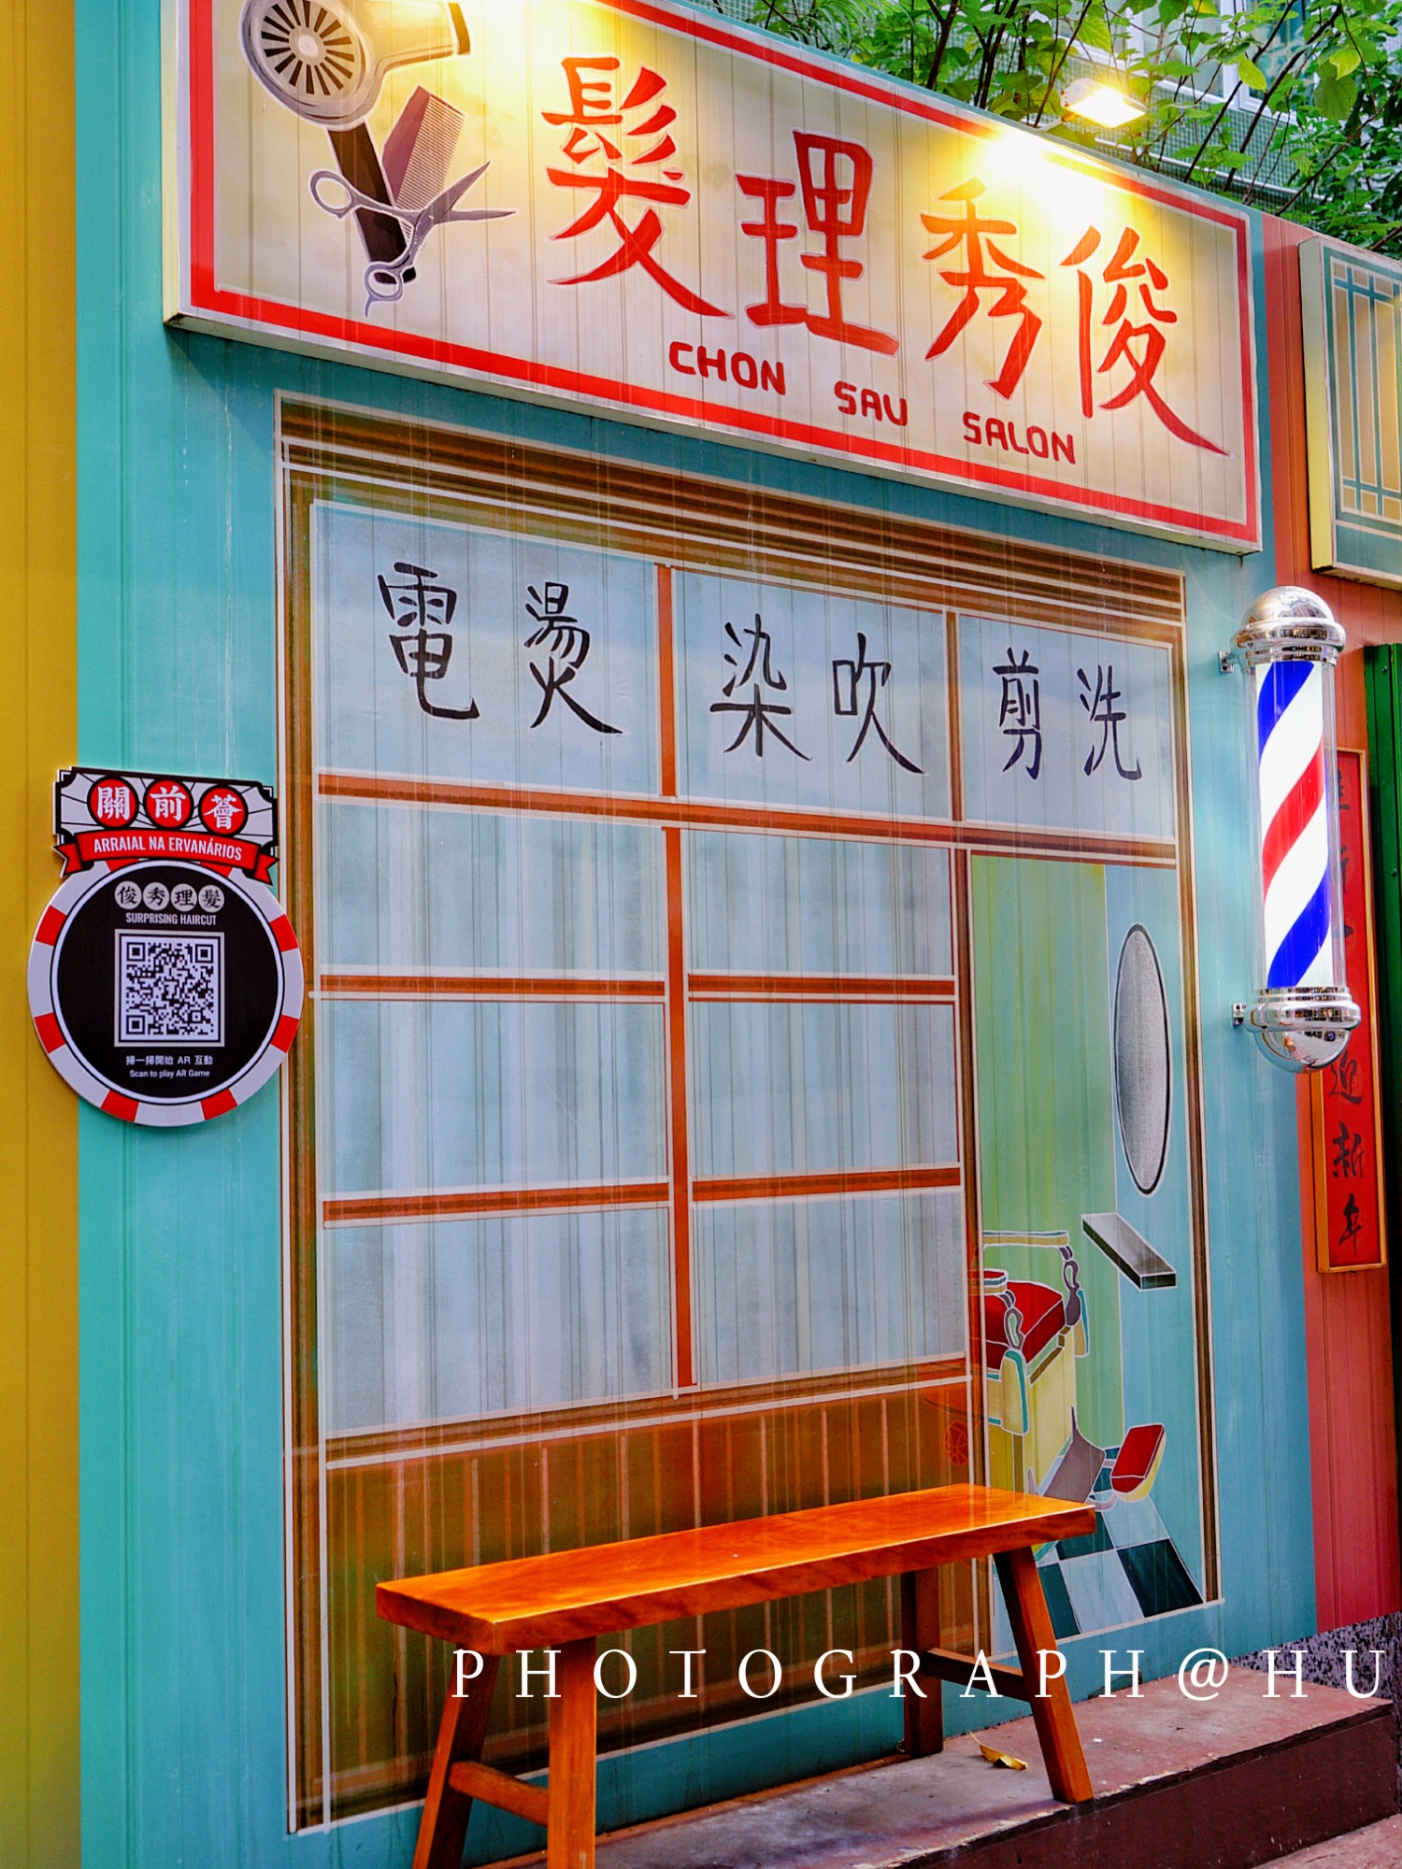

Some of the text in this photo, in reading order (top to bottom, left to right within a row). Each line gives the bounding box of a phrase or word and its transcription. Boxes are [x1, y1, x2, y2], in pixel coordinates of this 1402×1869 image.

[668, 340, 1077, 466] CHON SAU SALON
[97, 785, 243, 830] 關前薈
[94, 836, 243, 861] ARRAIAL NA ERVANÁRIOS
[116, 884, 222, 909] 俊秀理髮
[125, 912, 217, 926] SURPRISING HAIRCUT
[177, 1056, 191, 1065] AR
[129, 1069, 211, 1080] Scan to play AR Game
